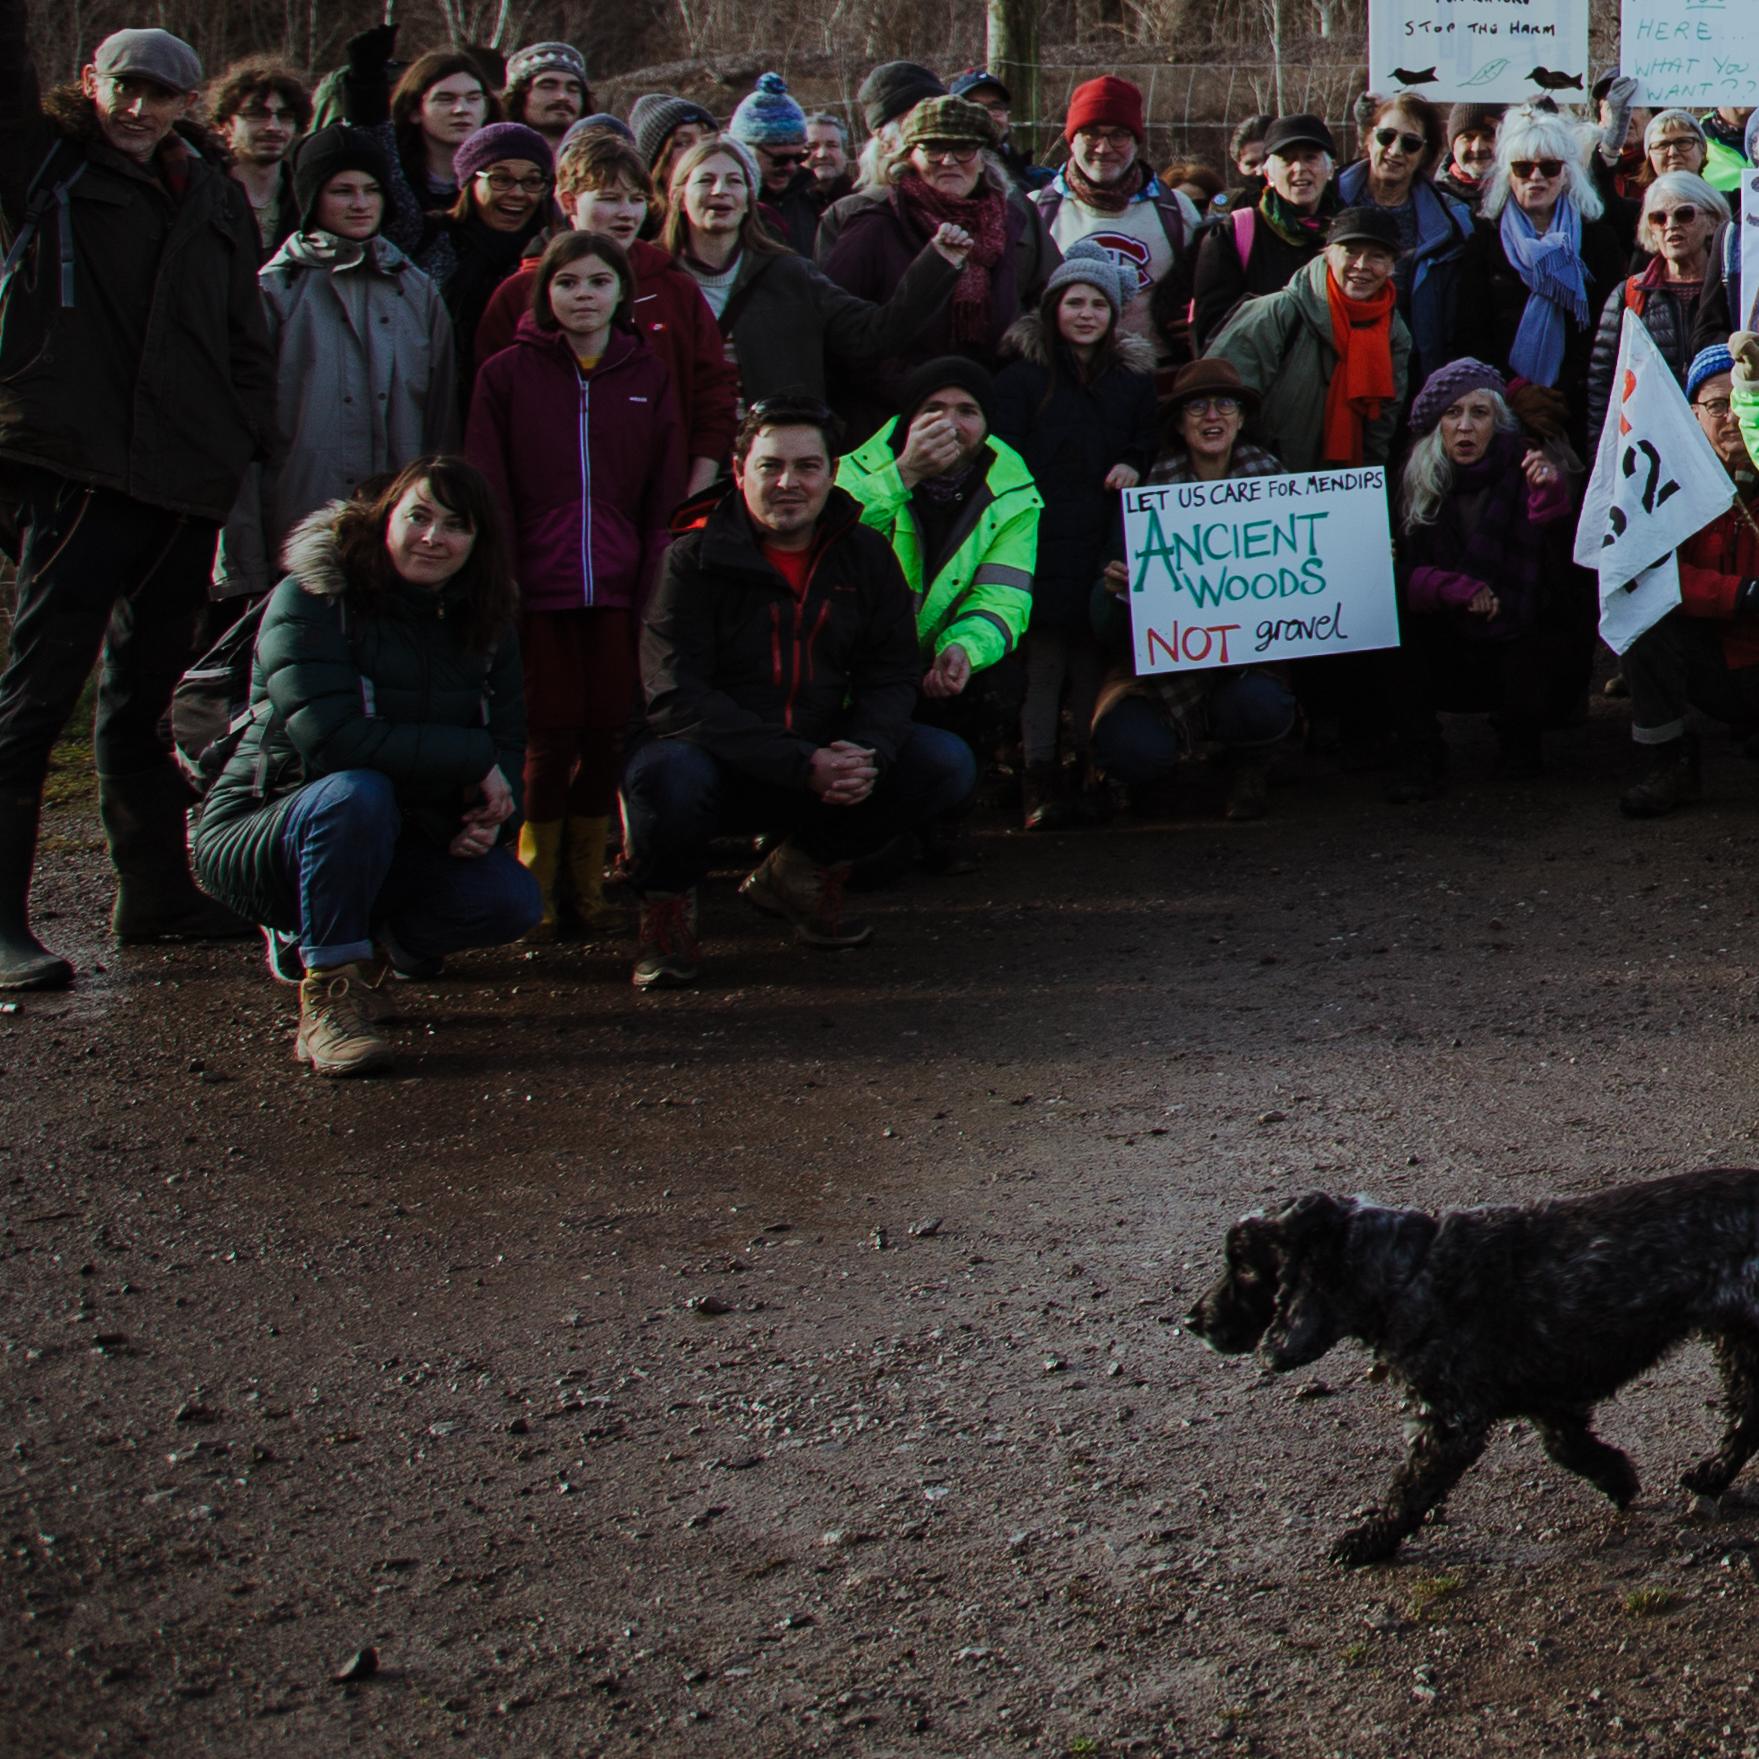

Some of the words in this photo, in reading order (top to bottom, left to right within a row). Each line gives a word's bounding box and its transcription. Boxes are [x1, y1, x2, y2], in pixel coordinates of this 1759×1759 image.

[1405, 21, 1455, 36] STOP
[1467, 22, 1497, 34] THE
[1510, 21, 1556, 36] HARM
[1635, 57, 1700, 77] WHAT
[1713, 55, 1749, 75] YOU
[1126, 490, 1170, 513] LET
[1179, 486, 1205, 508] US
[1210, 482, 1261, 505] CARE
[1269, 480, 1302, 497] FOR
[1306, 471, 1384, 495] MENDIPS
[1133, 504, 1329, 592] ANCIENT
[1183, 558, 1326, 608] WOODS
[1147, 620, 1241, 665] NOT
[1254, 602, 1348, 652] gravel
